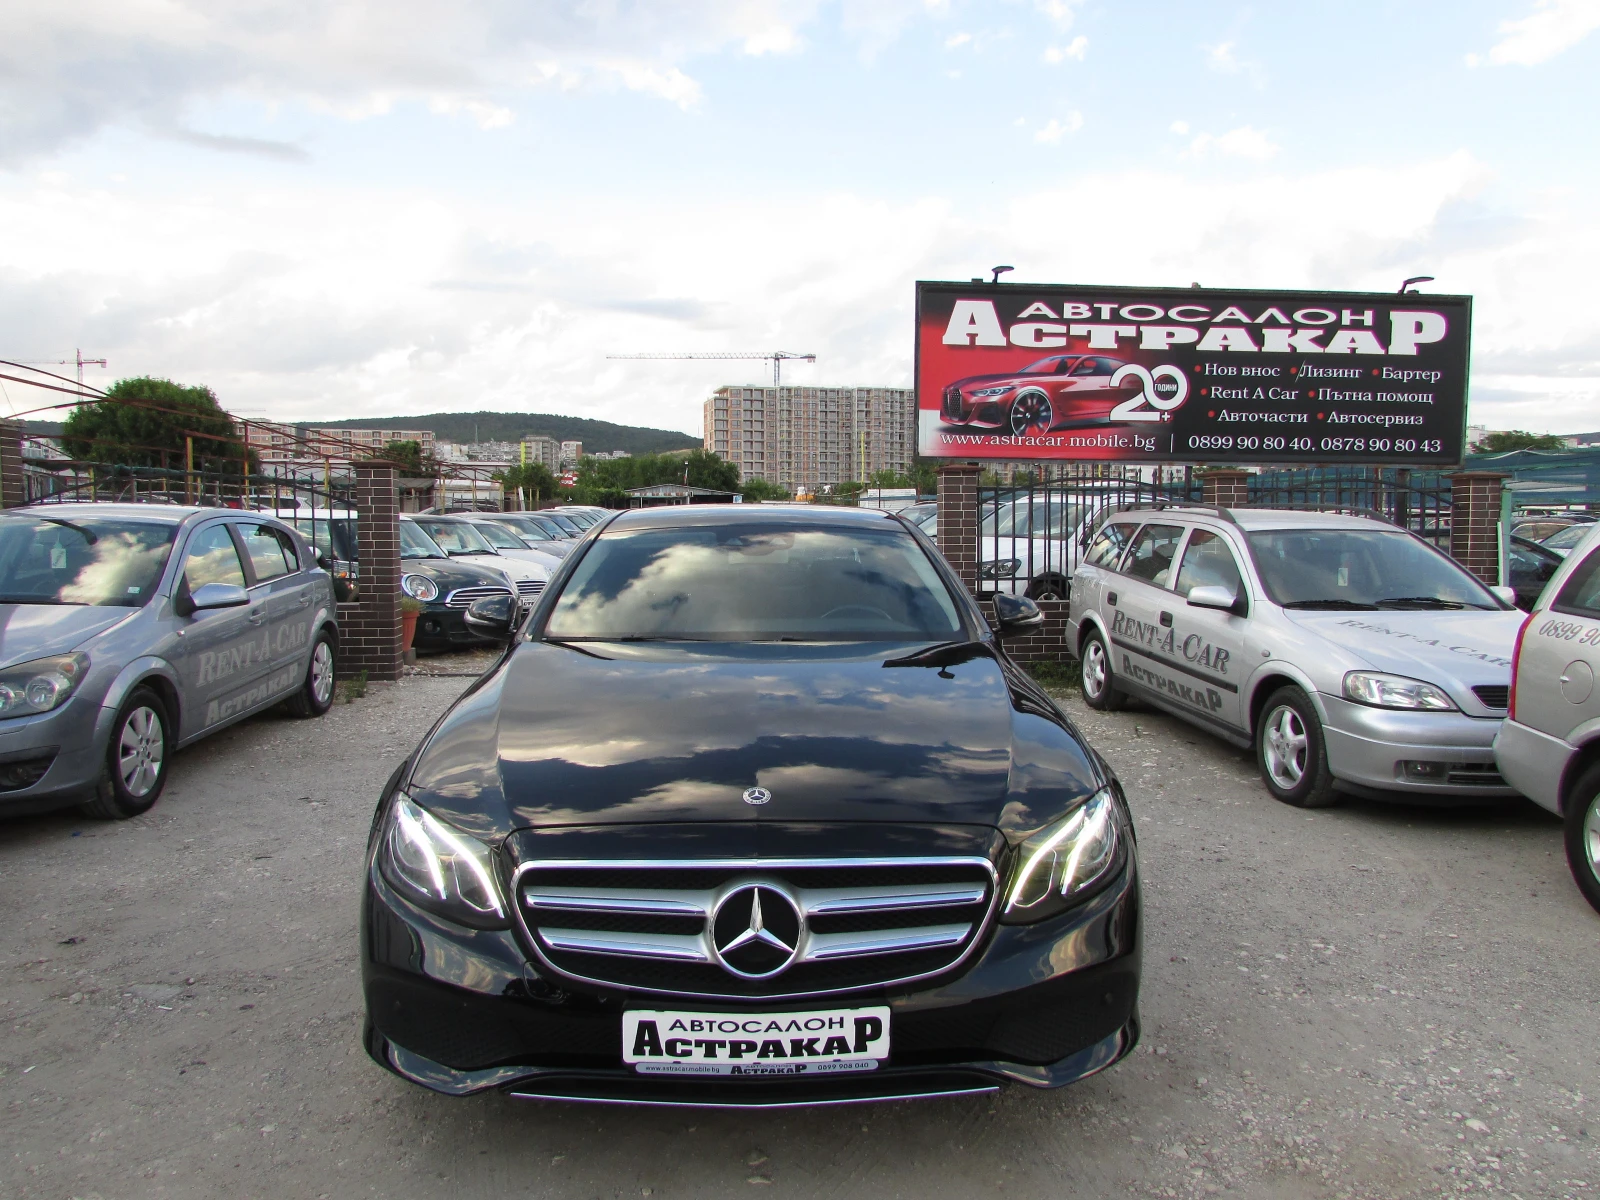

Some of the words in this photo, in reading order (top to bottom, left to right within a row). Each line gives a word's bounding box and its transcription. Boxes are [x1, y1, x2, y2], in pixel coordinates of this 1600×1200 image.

[1017, 302, 1373, 326] АВТОСАЛОН
[942, 299, 1446, 355] АСТРАКАР
[1204, 363, 1237, 376] Нов
[1241, 366, 1280, 377] внос
[1381, 366, 1441, 383] Бартер
[1154, 383, 1178, 392] ГОДИНИ
[1210, 386, 1249, 399] Rent
[1252, 387, 1265, 400] A
[1268, 387, 1299, 400] Car
[1318, 388, 1373, 401] Пътна
[1377, 391, 1434, 405] помощ
[1217, 409, 1309, 423] Авточасти
[1326, 411, 1424, 427] Автосервиз
[940, 433, 1156, 451] www.astracar.mobile.bg
[1188, 435, 1233, 449] 0899
[1237, 436, 1259, 450] 90
[1262, 436, 1285, 451] 80
[1321, 437, 1365, 451] 0878
[1369, 438, 1390, 452] 90
[1394, 439, 1416, 452] 80
[1420, 440, 1441, 453] 43
[1539, 619, 1584, 641] 0899
[1110, 609, 1231, 675] RENT-A-CAR
[195, 622, 307, 688] RENT-A-CAR
[668, 1016, 844, 1033] АВТОСАЛОН
[632, 1016, 883, 1059] АСТРАКАР
